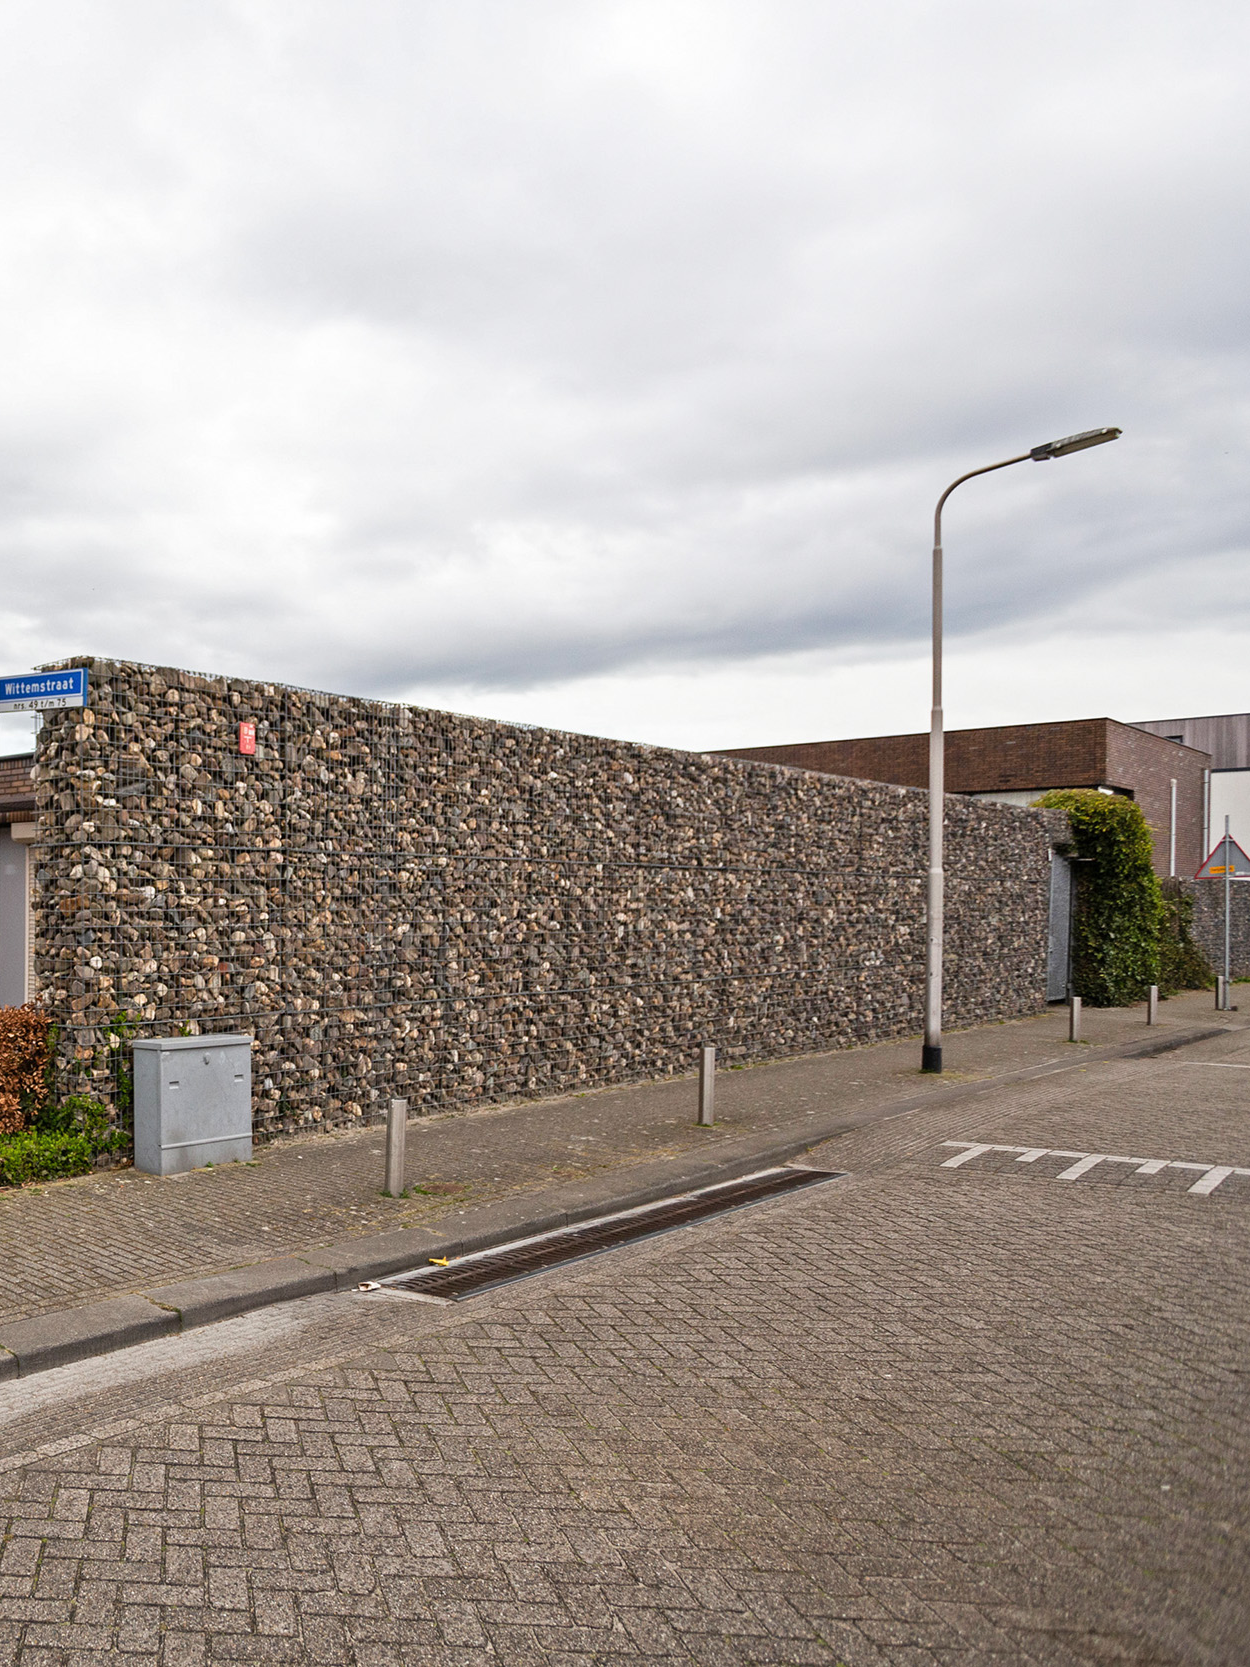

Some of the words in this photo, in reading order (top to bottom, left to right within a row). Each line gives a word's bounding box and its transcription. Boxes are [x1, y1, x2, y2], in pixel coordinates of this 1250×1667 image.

[5, 677, 74, 695] Wittemstraat
[13, 702, 26, 710] nrs.
[28, 700, 38, 709] 49
[40, 699, 55, 709] t/m
[57, 698, 67, 707] 75
